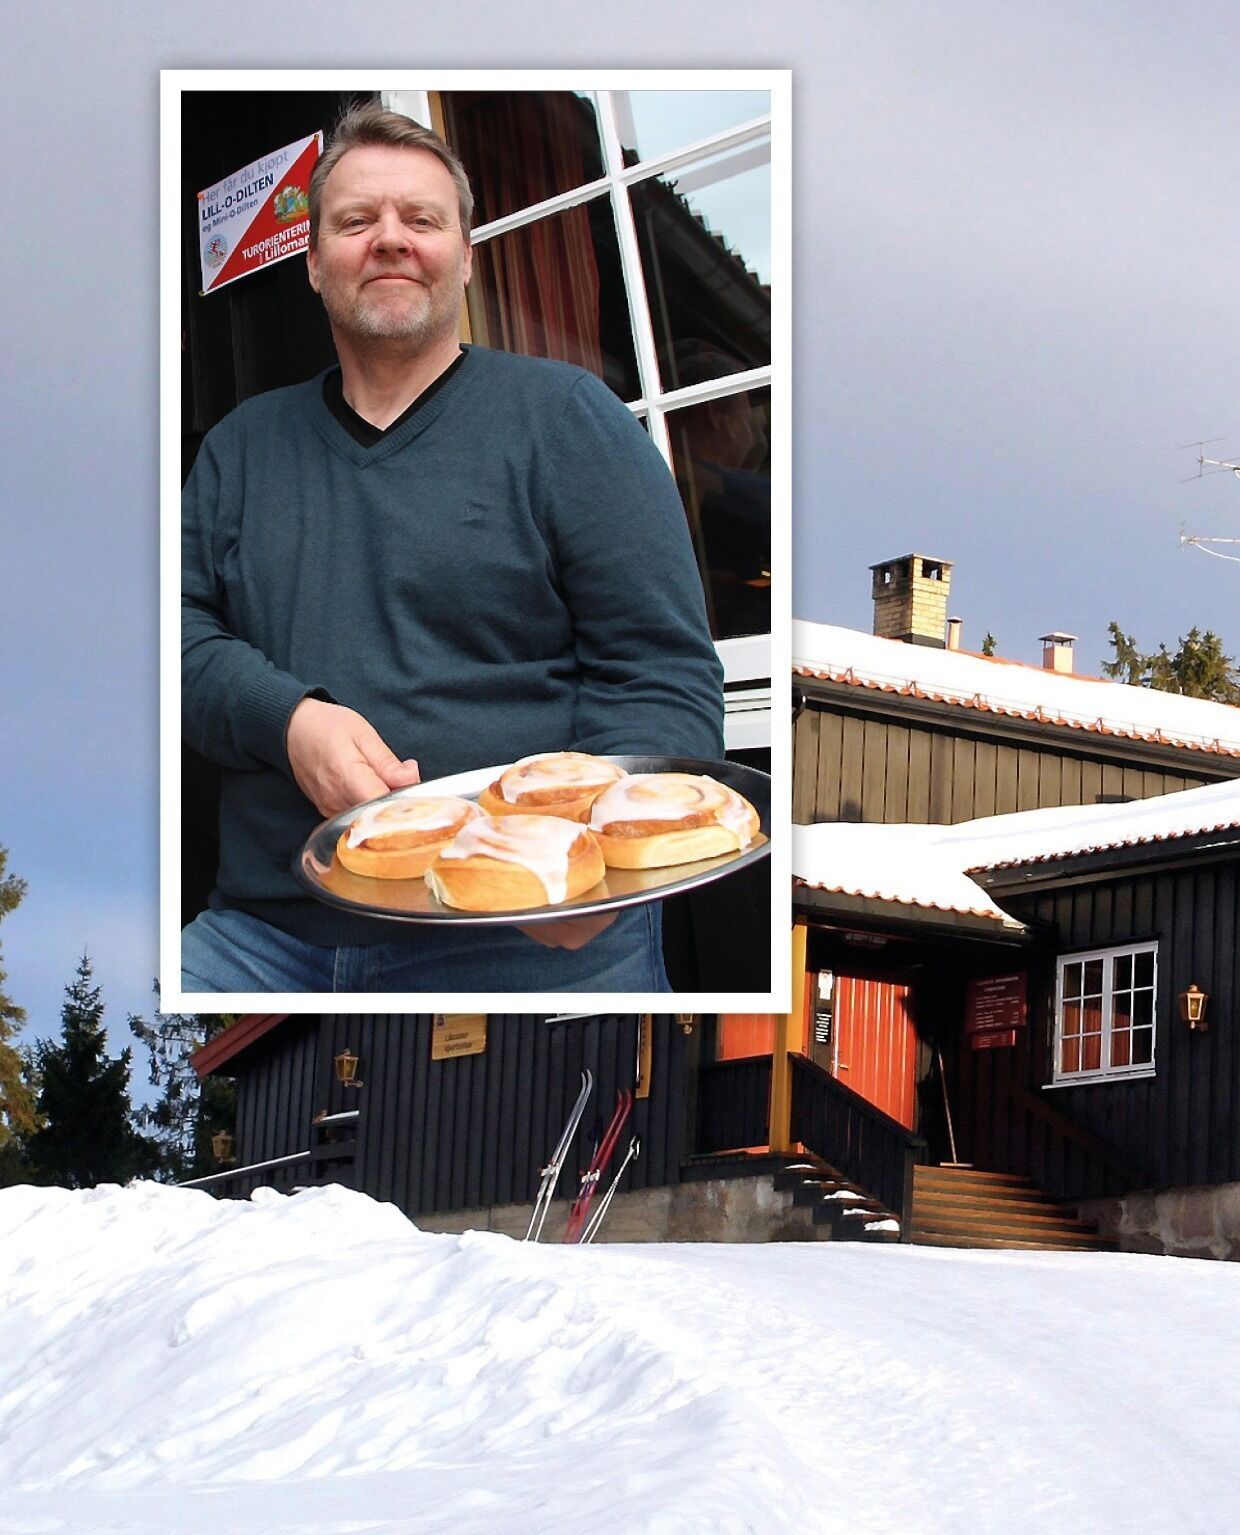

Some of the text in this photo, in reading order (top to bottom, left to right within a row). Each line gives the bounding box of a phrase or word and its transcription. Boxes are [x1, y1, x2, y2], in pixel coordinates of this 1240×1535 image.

[202, 151, 289, 205] Her får du kjøpt
[202, 173, 274, 221] LILL-O-DILTEN
[202, 220, 213, 232] og
